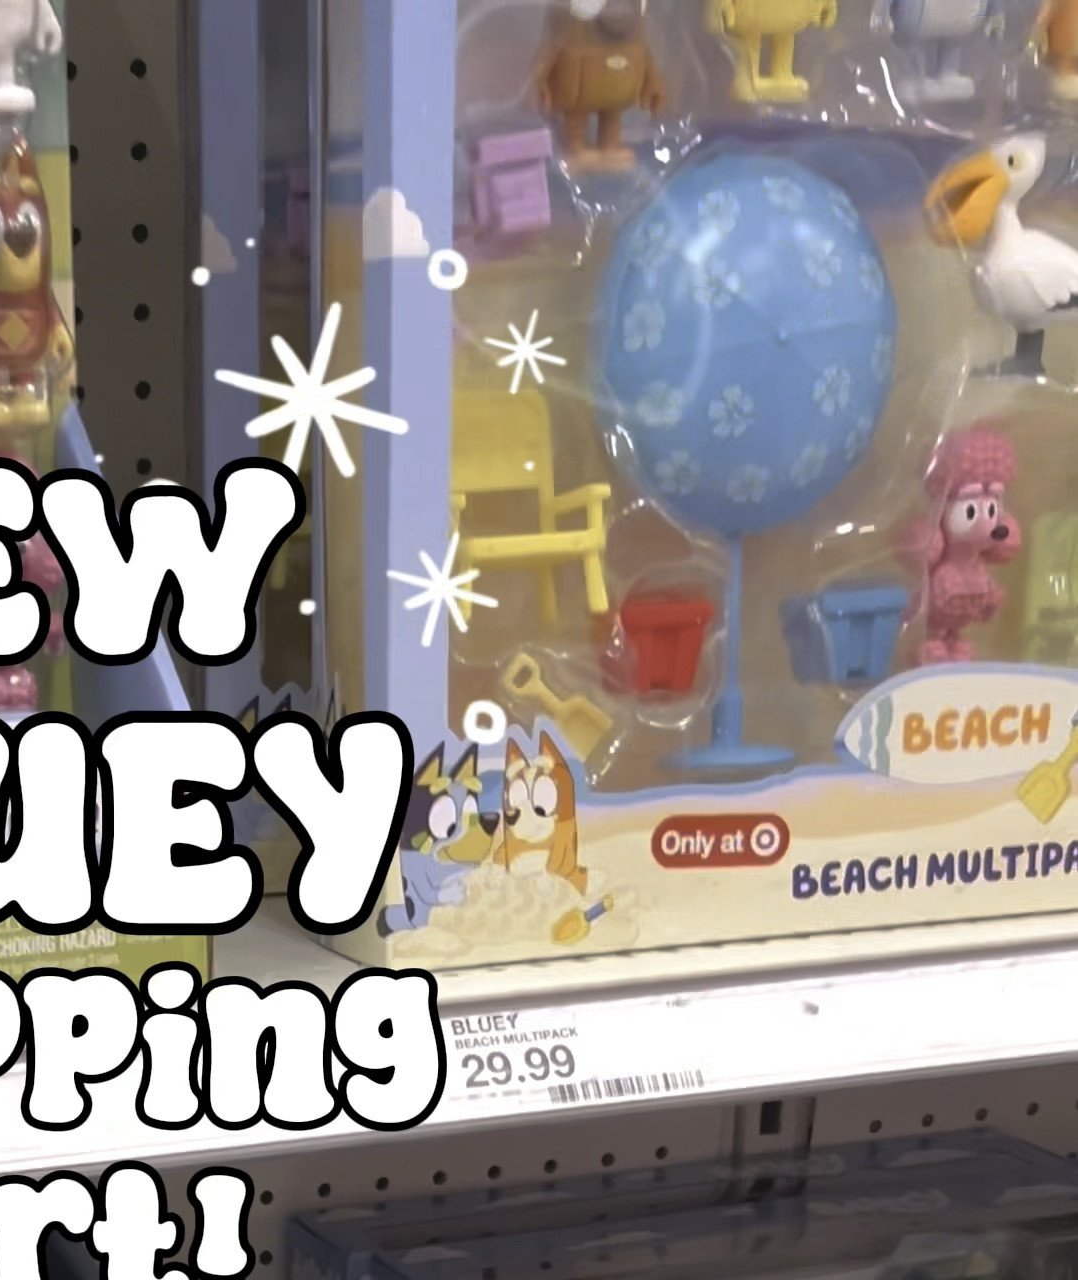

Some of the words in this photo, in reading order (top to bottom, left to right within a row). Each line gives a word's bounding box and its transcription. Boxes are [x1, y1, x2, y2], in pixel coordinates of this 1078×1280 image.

[902, 703, 1052, 755] BEACH
[660, 831, 714, 859] Only
[720, 829, 744, 853] at
[791, 853, 918, 901] BEACH
[926, 839, 1078, 888] MULTIPA
[59, 926, 116, 952] HAZARD
[451, 1013, 519, 1036] BLUEY
[455, 1036, 500, 1050] BEACH
[504, 1027, 578, 1045] MULTIPACK
[462, 1044, 576, 1088] 29.99
